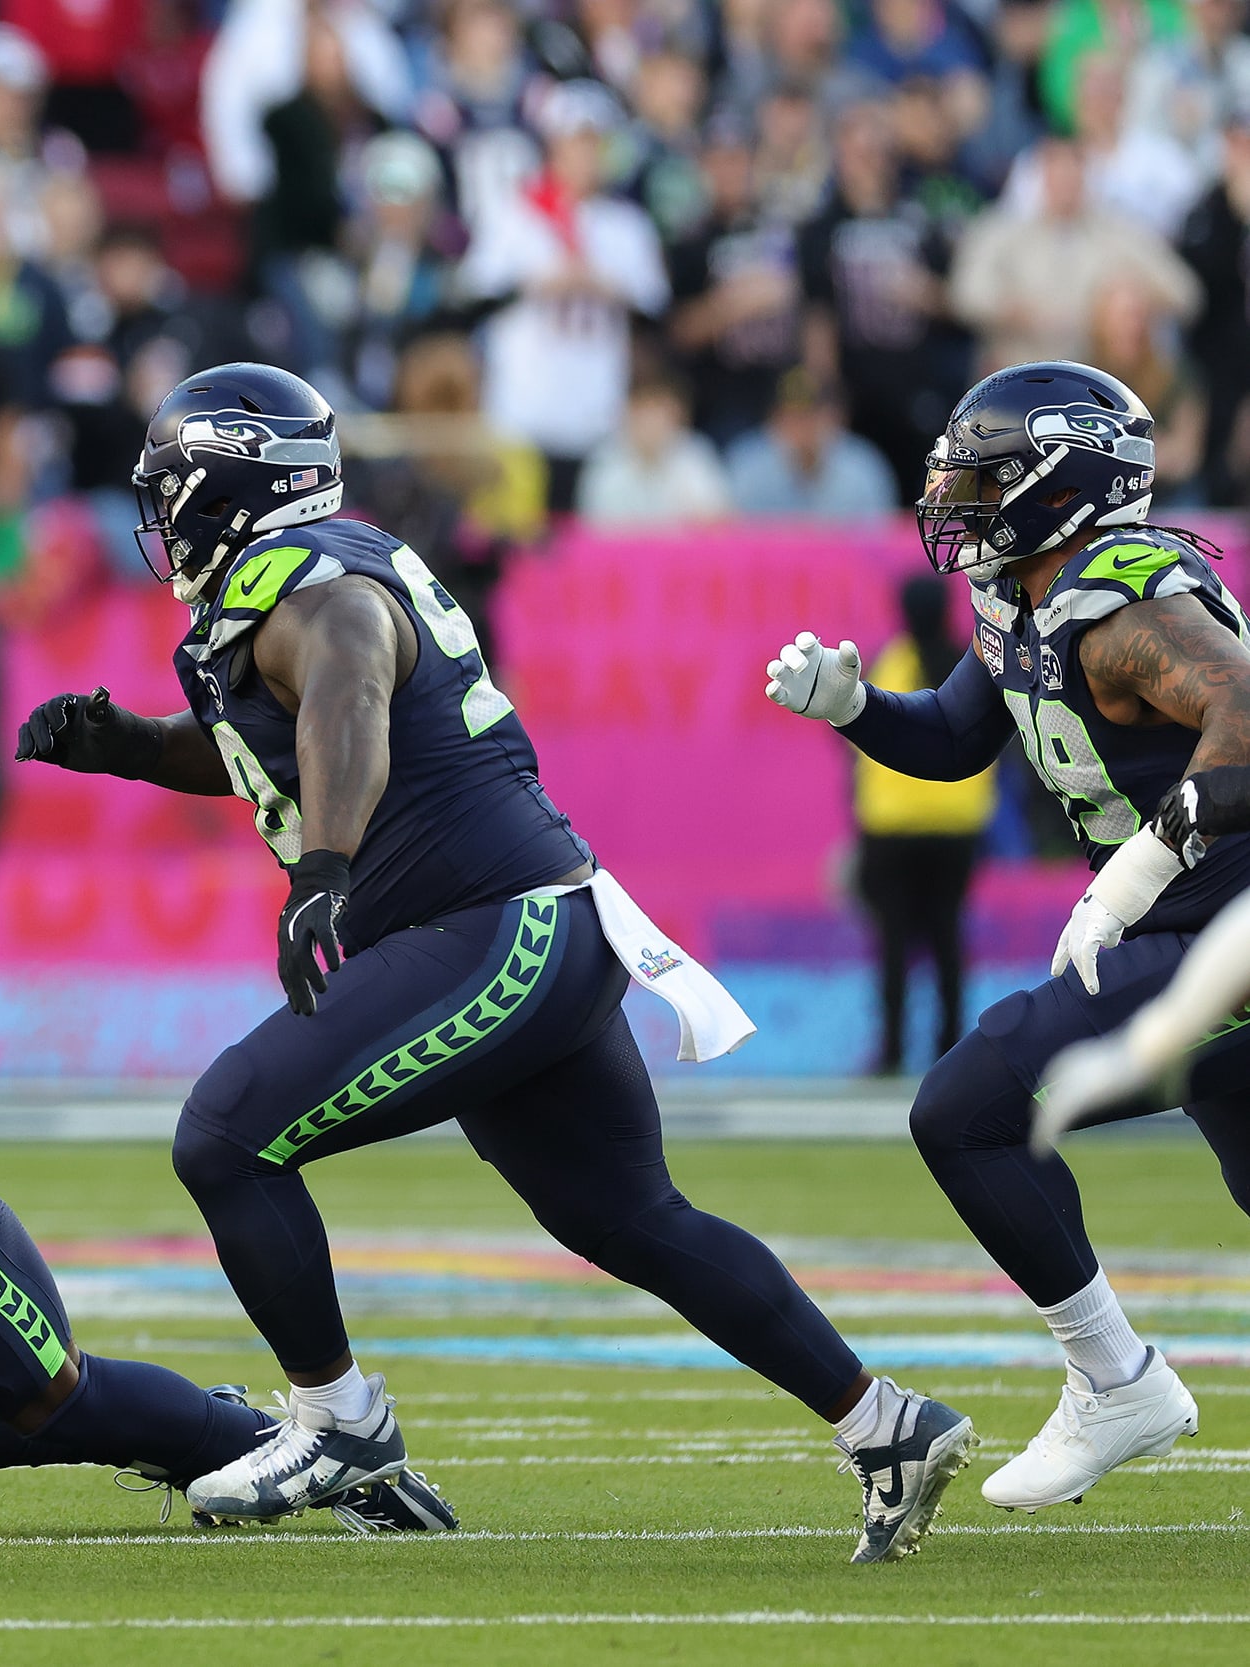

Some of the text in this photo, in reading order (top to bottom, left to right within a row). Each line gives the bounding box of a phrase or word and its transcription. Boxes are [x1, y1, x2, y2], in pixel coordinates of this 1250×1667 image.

[271, 479, 288, 494] 45
[1127, 476, 1140, 491] 45
[982, 630, 1001, 650] USA
